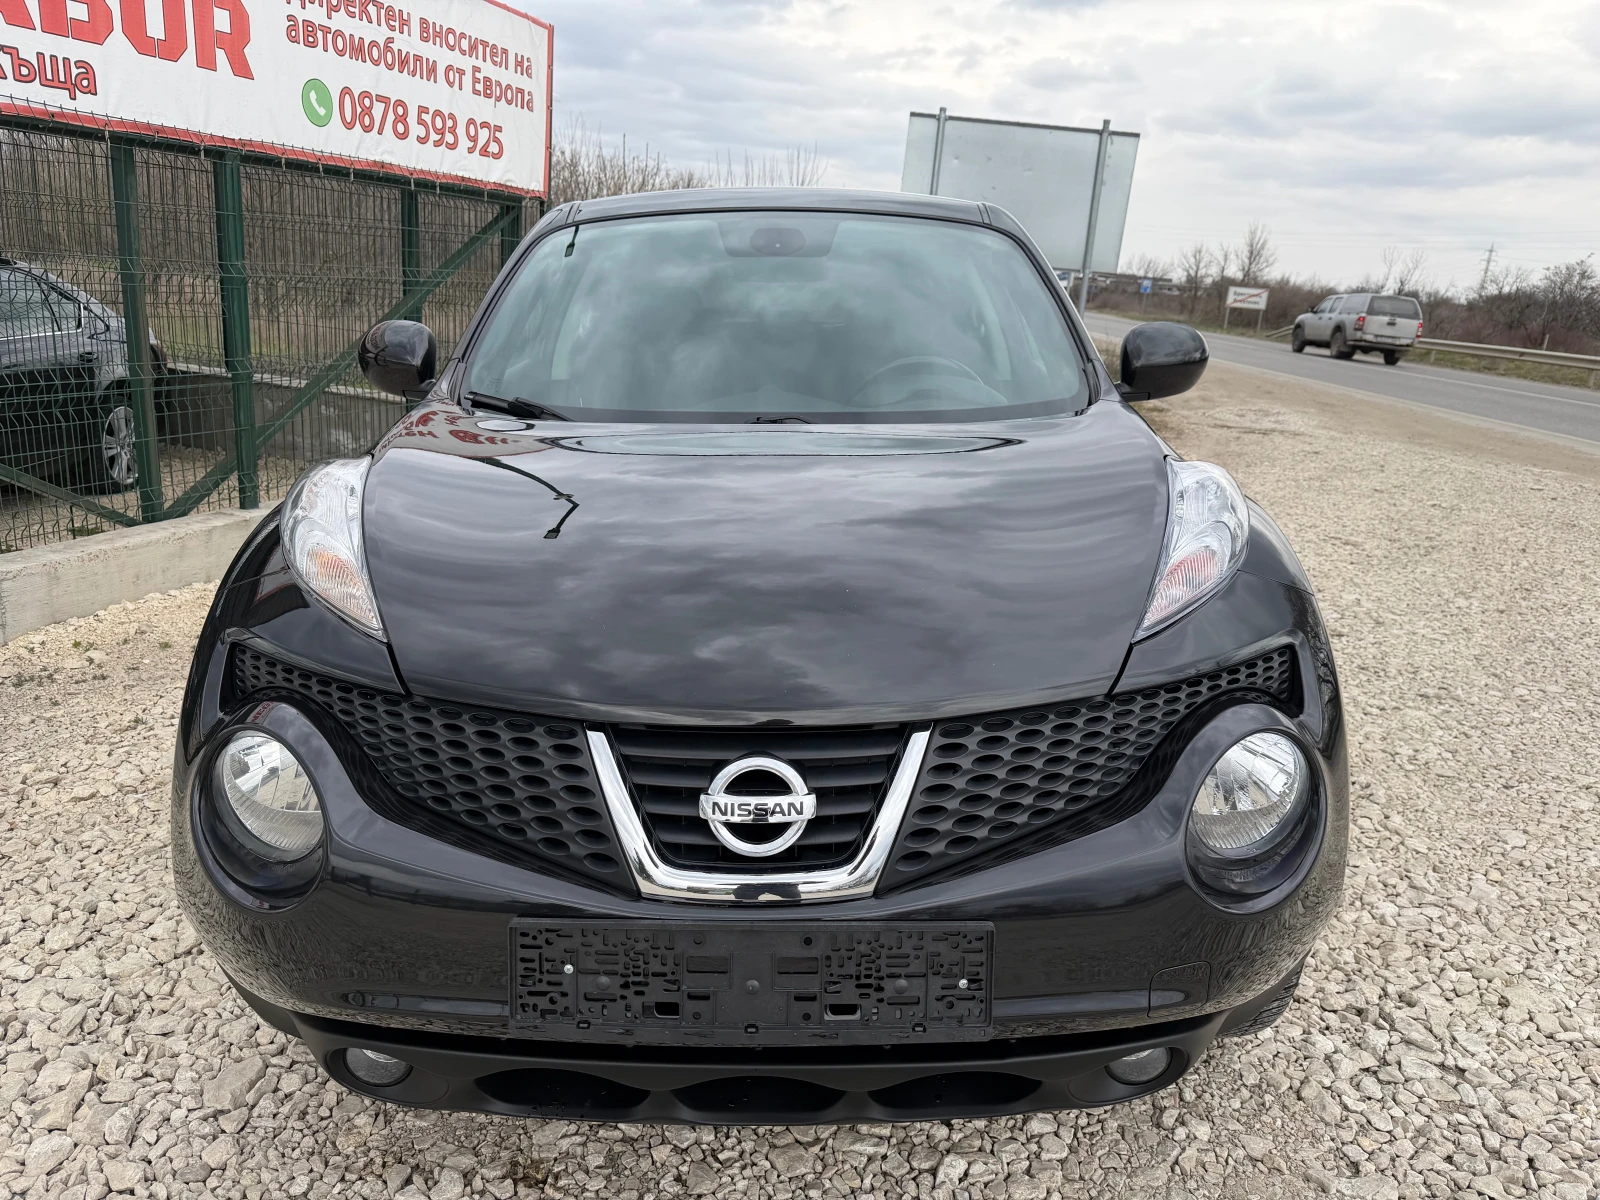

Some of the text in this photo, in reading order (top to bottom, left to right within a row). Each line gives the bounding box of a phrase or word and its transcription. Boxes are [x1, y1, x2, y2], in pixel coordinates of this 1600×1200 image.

[286, 0, 533, 79] ректен вносител на
[286, 14, 534, 113] автомобили от Европа
[338, 86, 504, 160] 0878 593 925
[711, 801, 804, 818] NISSAN
